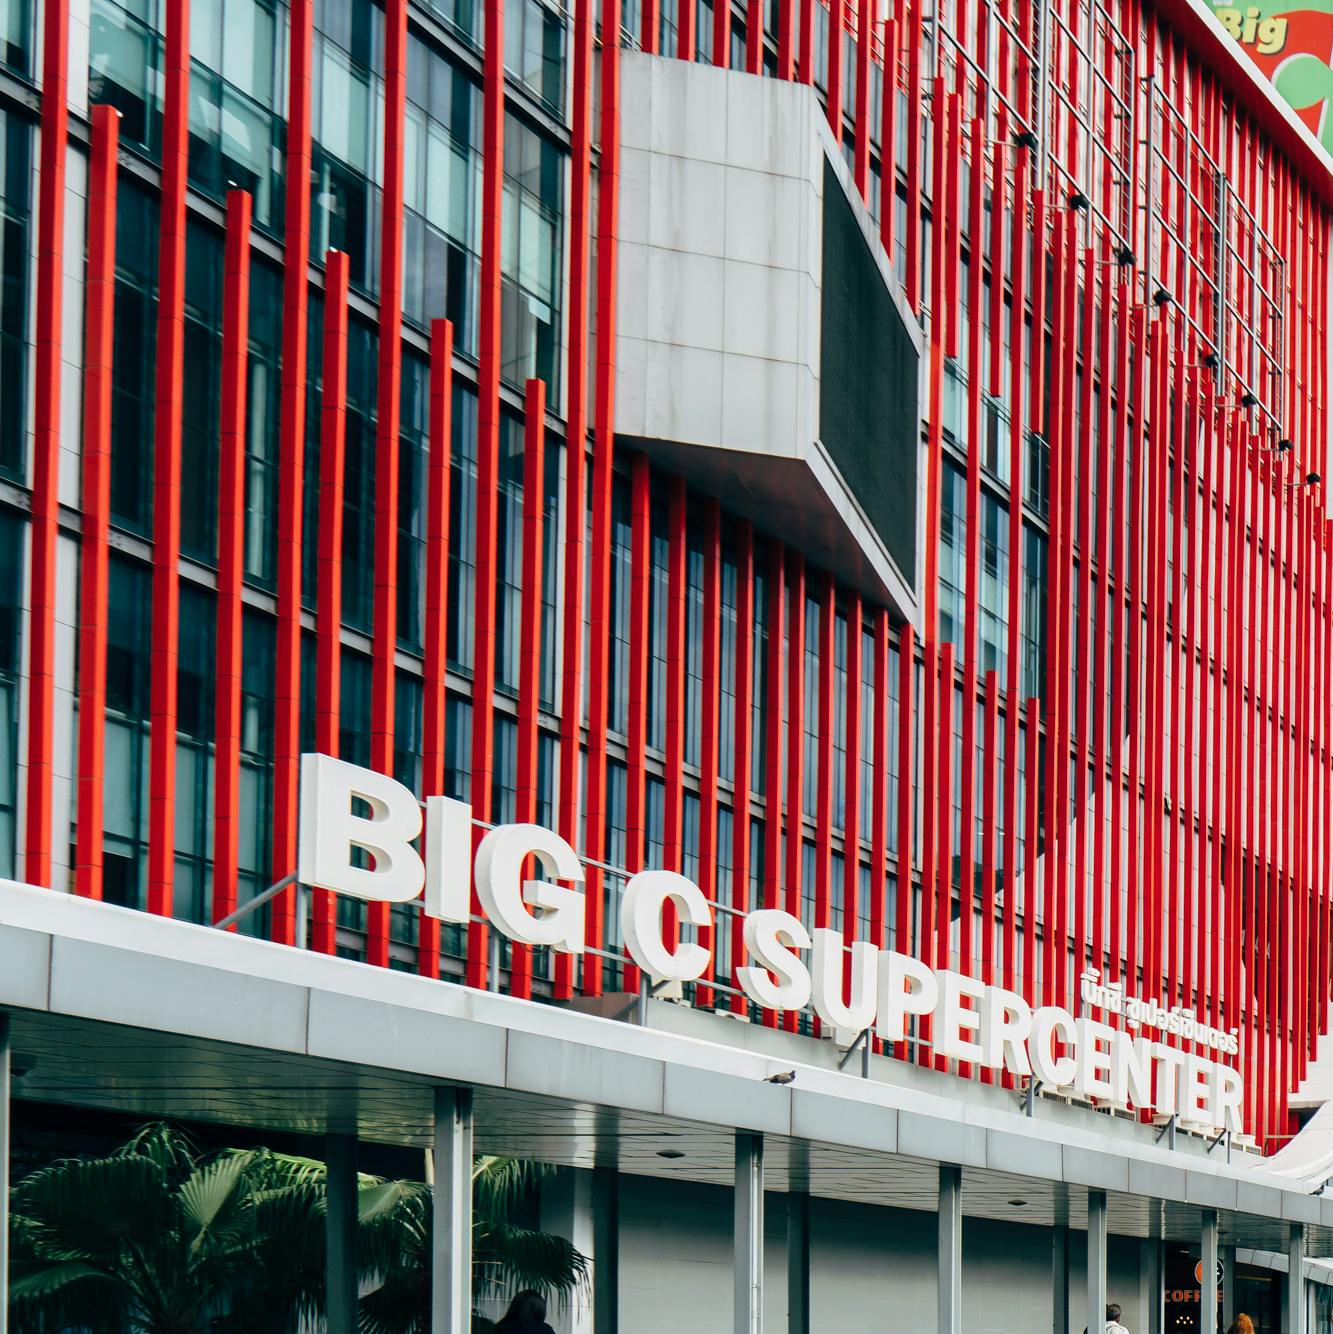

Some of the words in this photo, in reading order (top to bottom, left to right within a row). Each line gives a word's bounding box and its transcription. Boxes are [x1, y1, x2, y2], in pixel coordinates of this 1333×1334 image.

[1214, 7, 1287, 55] Big
[299, 752, 585, 954] BIG
[621, 869, 712, 982] C
[737, 908, 1243, 1134] SUPERCENTER
[1080, 966, 1121, 1014] บิ๊กซี
[1164, 1288, 1223, 1302] COFFE
